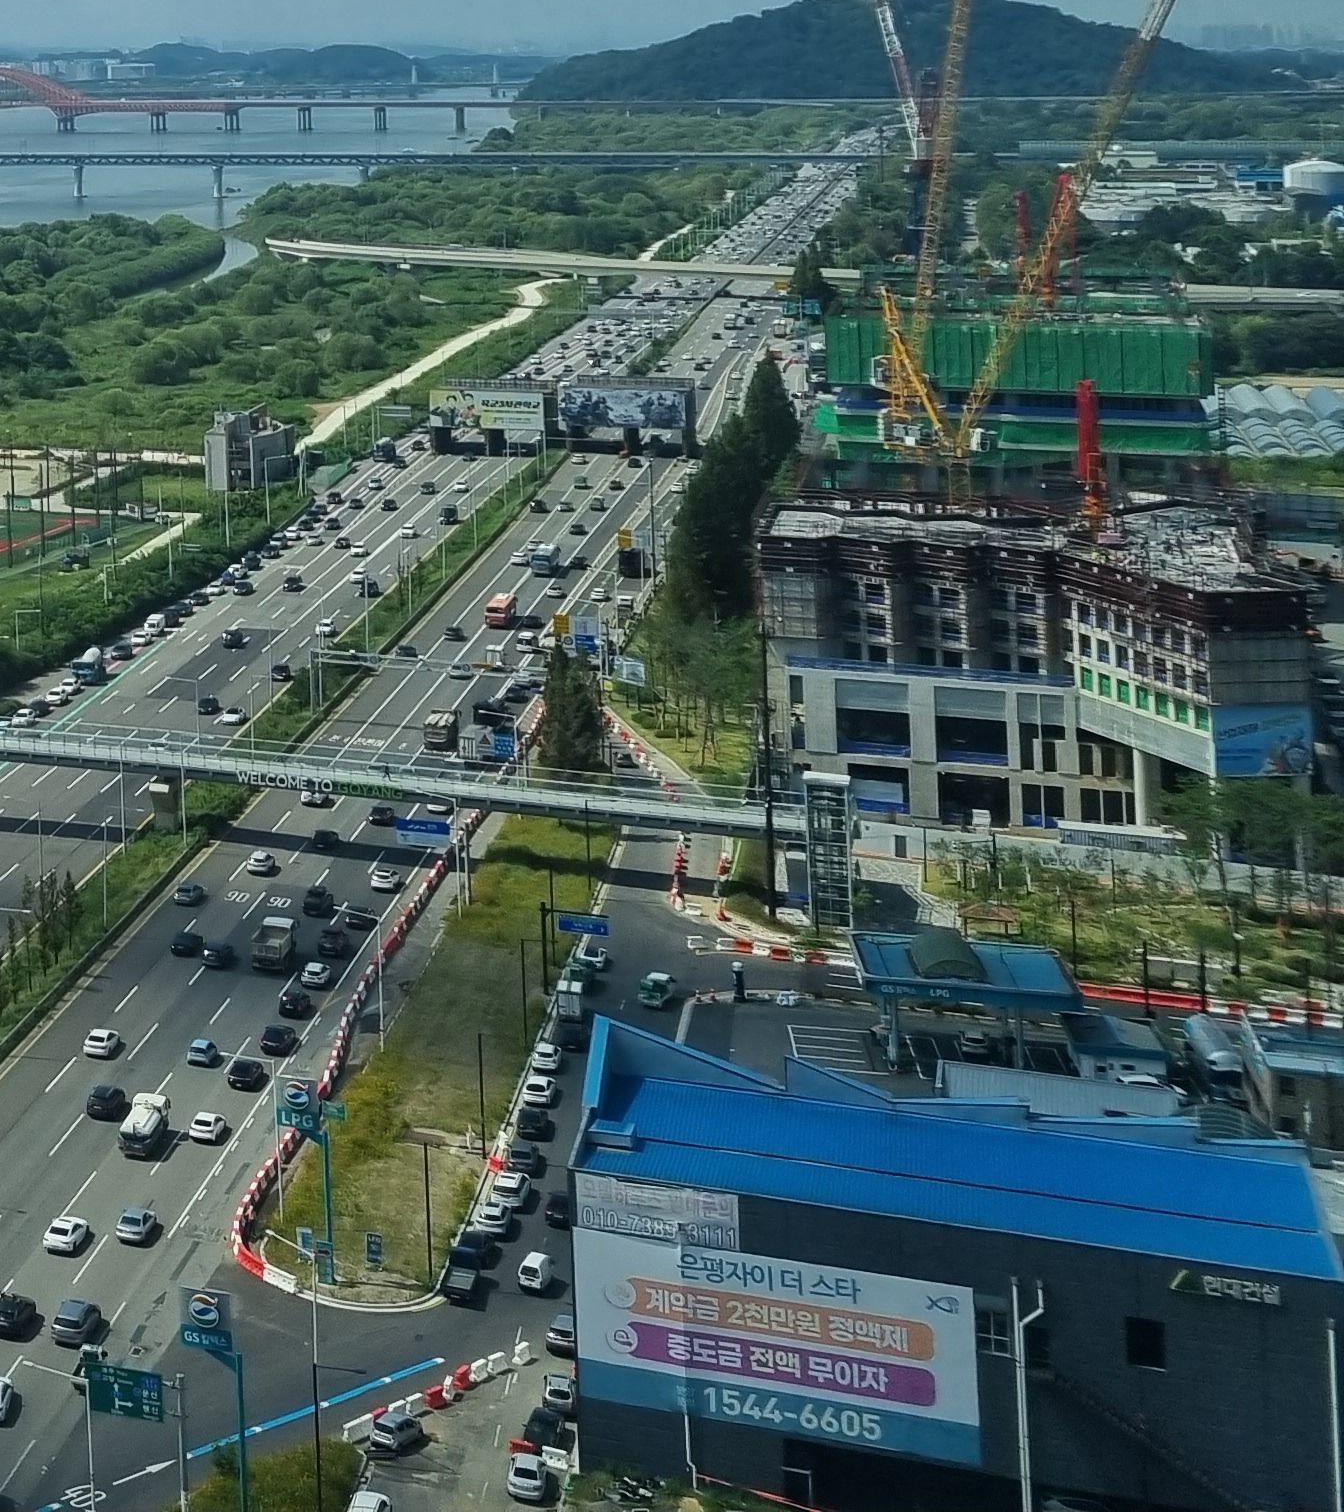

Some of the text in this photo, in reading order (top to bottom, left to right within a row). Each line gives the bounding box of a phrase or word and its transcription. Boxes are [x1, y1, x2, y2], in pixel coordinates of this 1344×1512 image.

[236, 771, 403, 799] WELCOME TO GOYANG
[224, 890, 250, 903] 90
[267, 896, 292, 908] 90
[881, 984, 895, 994] GS
[929, 988, 951, 998] LPG
[281, 1110, 314, 1128] LPG
[677, 1253, 861, 1304] 은평자이 더 스타
[645, 1288, 910, 1353] 계약금 2천만원 정액제
[184, 1330, 200, 1344] GS
[667, 1334, 889, 1394] 중도금 전액 무이자
[702, 1386, 882, 1441] 1544-6605
